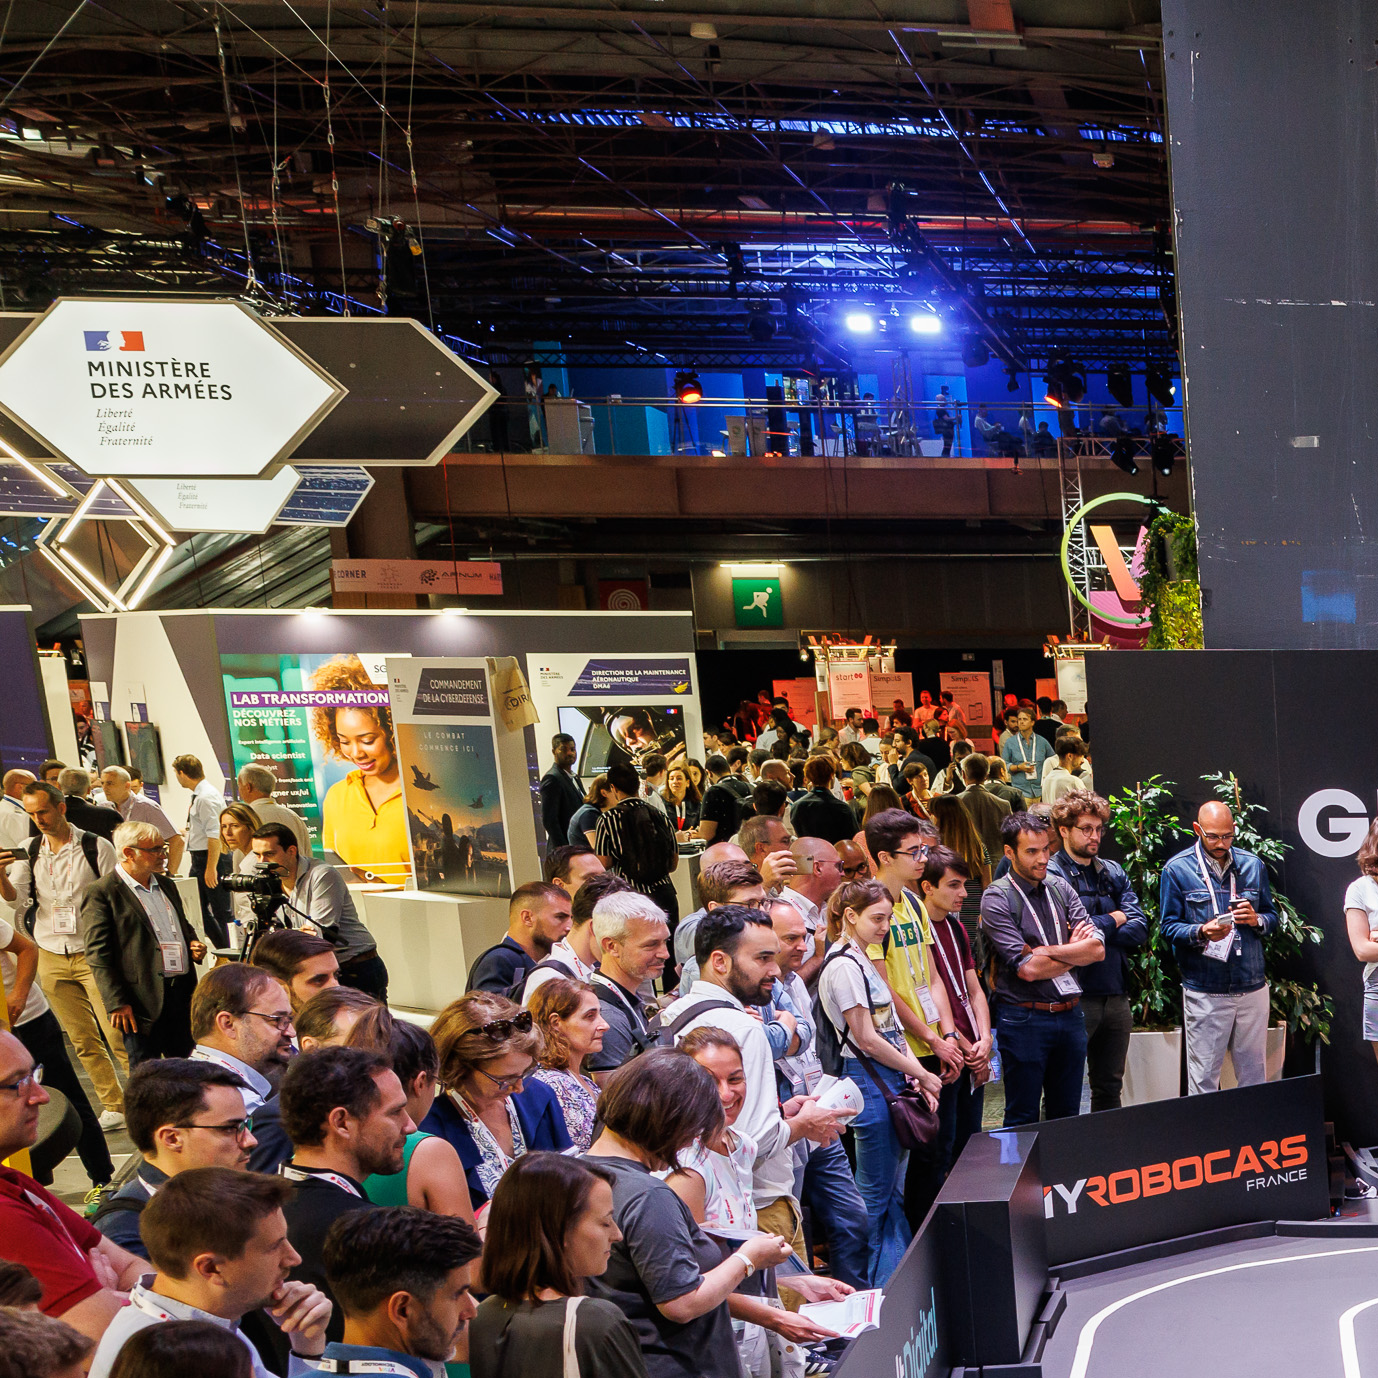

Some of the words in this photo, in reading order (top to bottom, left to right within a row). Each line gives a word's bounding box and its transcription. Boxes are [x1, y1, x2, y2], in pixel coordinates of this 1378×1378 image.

[87, 357, 212, 379] MINISTÈRE
[90, 382, 135, 399] DES
[141, 379, 233, 401] ARMÉES
[96, 408, 134, 418] Liberté
[97, 421, 136, 434] Égalité
[99, 435, 154, 446] Fraternité
[429, 680, 482, 690] COMMANDEMENT
[233, 693, 260, 705] LAB
[261, 692, 389, 705] TRANSFORMATION
[423, 693, 431, 702] DE
[432, 693, 440, 702] LA
[233, 708, 296, 718] DÉCOUVREZ
[234, 718, 257, 727] NOS
[259, 717, 302, 726] MÉTIERS
[436, 732, 465, 740] COMBAT
[419, 744, 459, 752] COMMENCE
[1246, 1167, 1308, 1192] FRANCE
